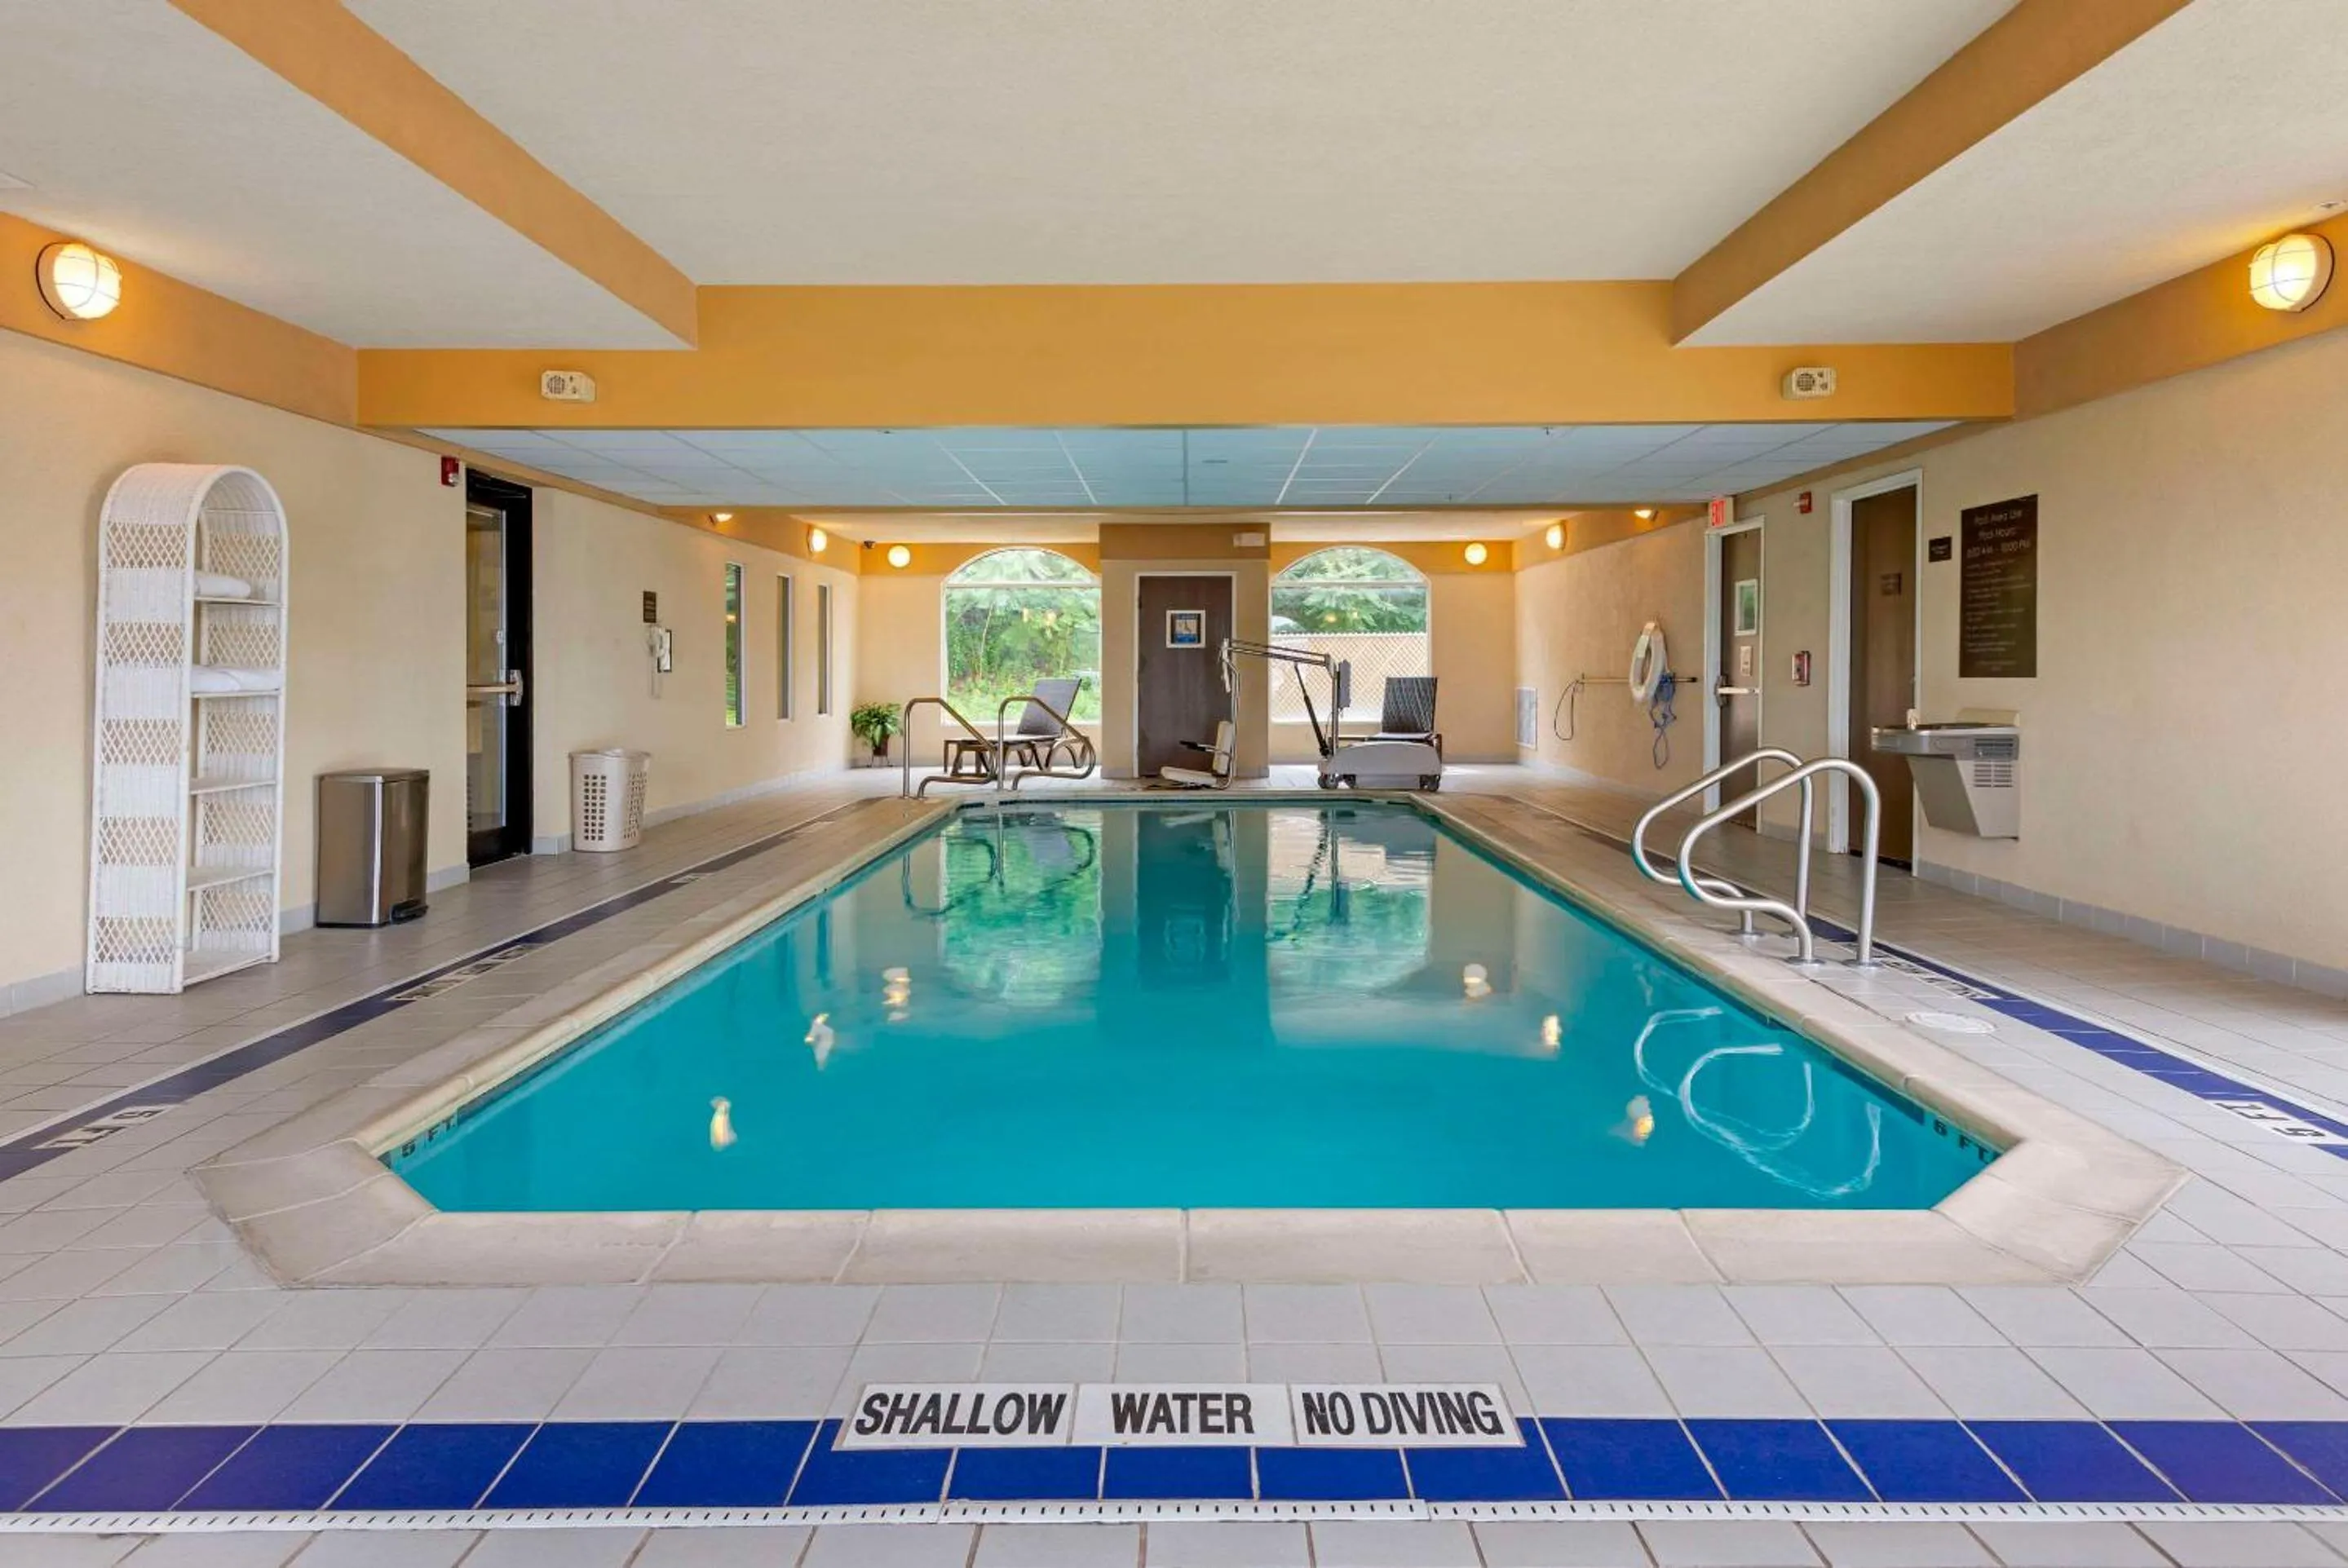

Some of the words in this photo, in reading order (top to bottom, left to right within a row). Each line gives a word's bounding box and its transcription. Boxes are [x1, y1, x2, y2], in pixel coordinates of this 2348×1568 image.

[856, 1392, 1067, 1435] SHALLOW
[1112, 1393, 1254, 1433] WATER
[1302, 1392, 1355, 1435] NO
[1360, 1391, 1506, 1435] DIVING
